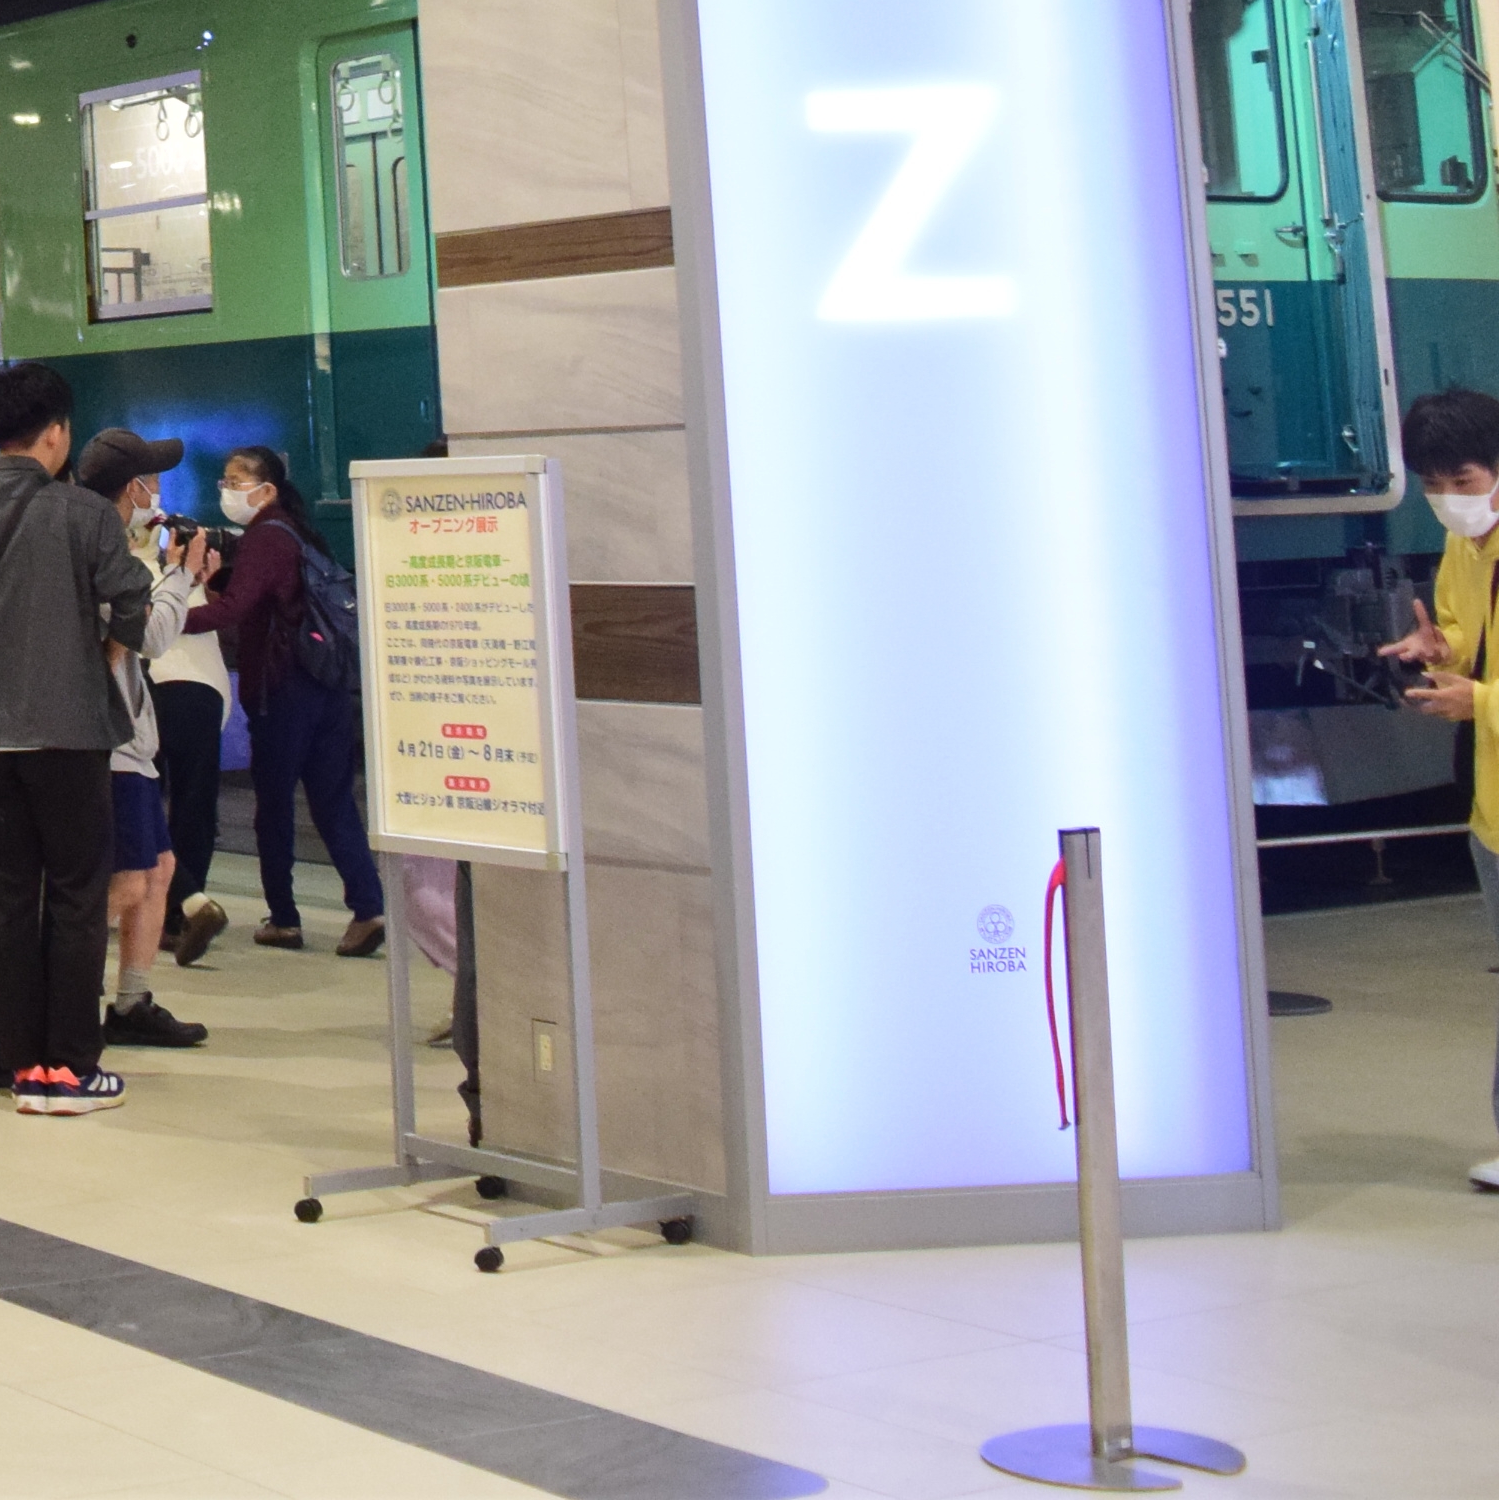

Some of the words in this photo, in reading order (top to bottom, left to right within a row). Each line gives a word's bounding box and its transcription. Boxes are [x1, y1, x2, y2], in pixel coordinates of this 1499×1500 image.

[803, 80, 1020, 325] Z
[1216, 288, 1274, 327] 551
[405, 491, 528, 514] SANZEN-HIROBA
[409, 516, 499, 535] オープニング展示
[969, 947, 1026, 960] SANZEN
[970, 961, 1027, 974] HIROBA
